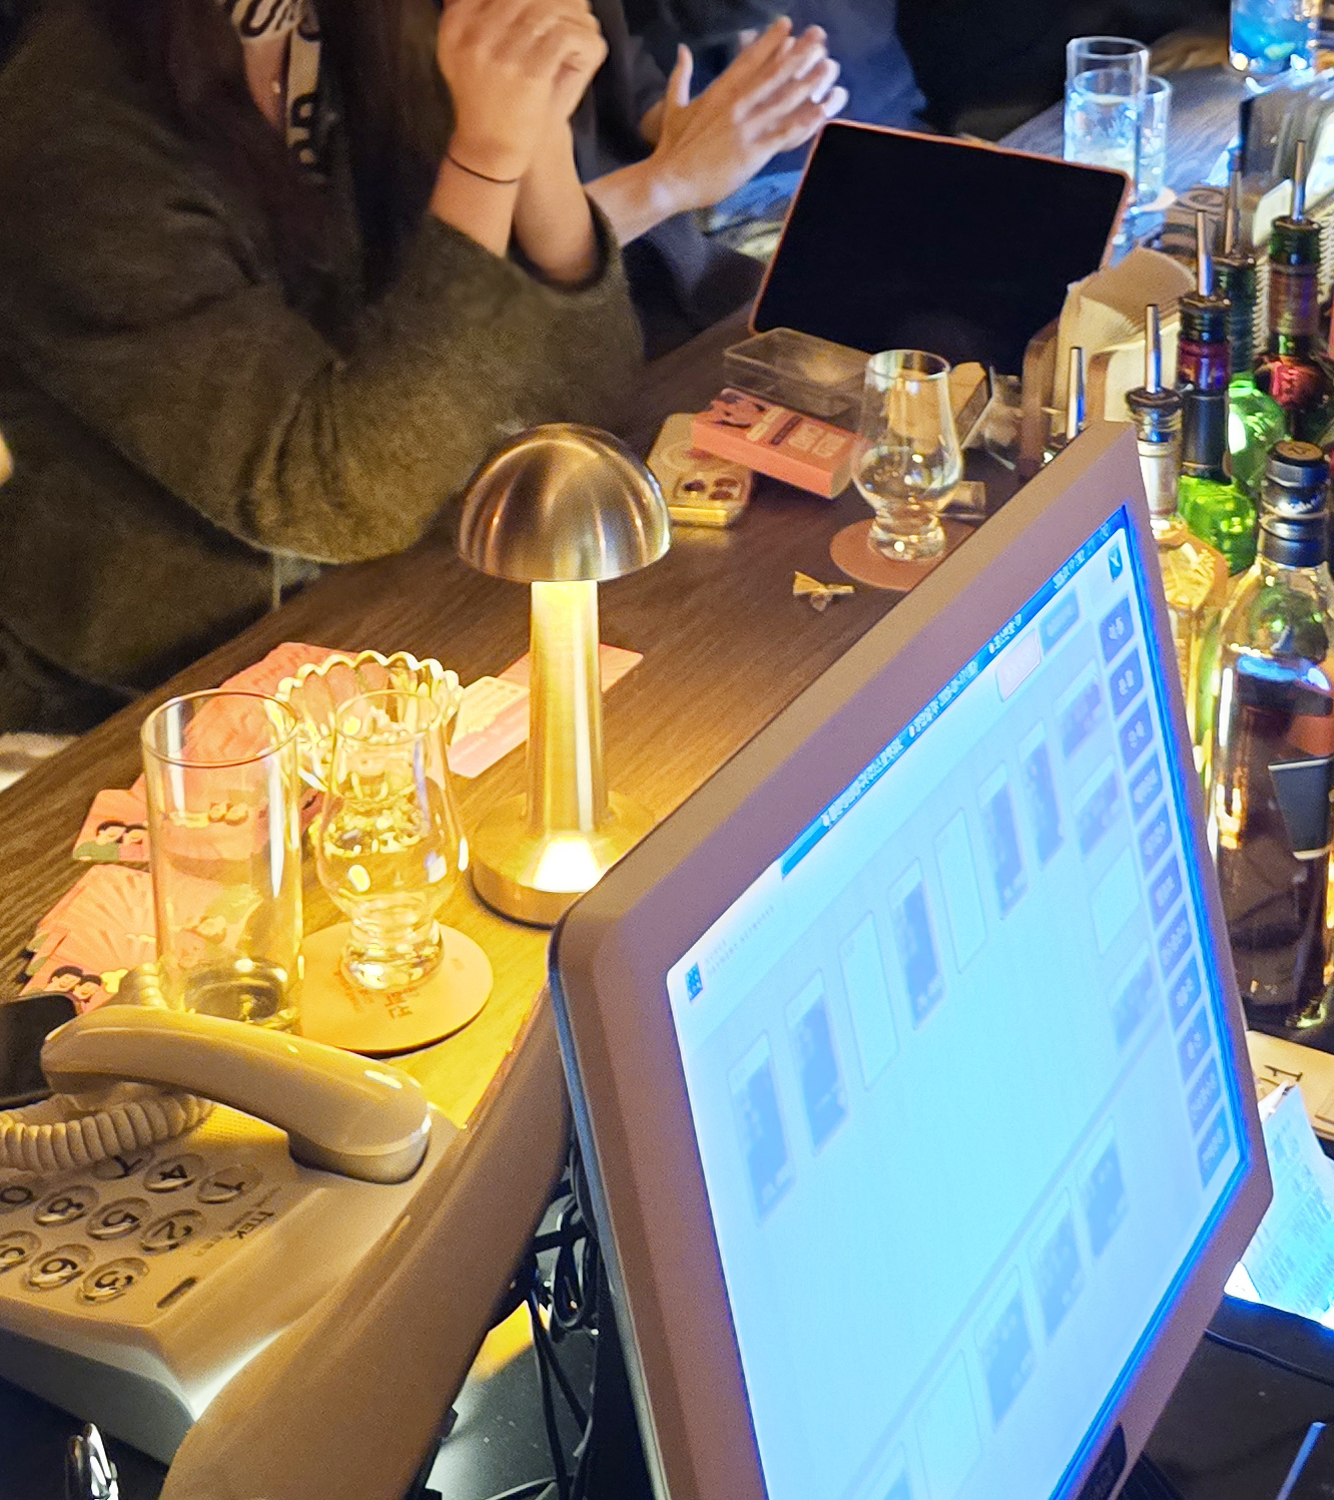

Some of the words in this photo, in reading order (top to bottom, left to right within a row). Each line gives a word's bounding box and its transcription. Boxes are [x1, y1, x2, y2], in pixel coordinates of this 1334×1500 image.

[101, 1206, 140, 1228] 5
[166, 1219, 193, 1242] 2
[40, 1255, 79, 1276] 6
[96, 1271, 134, 1290] 3
